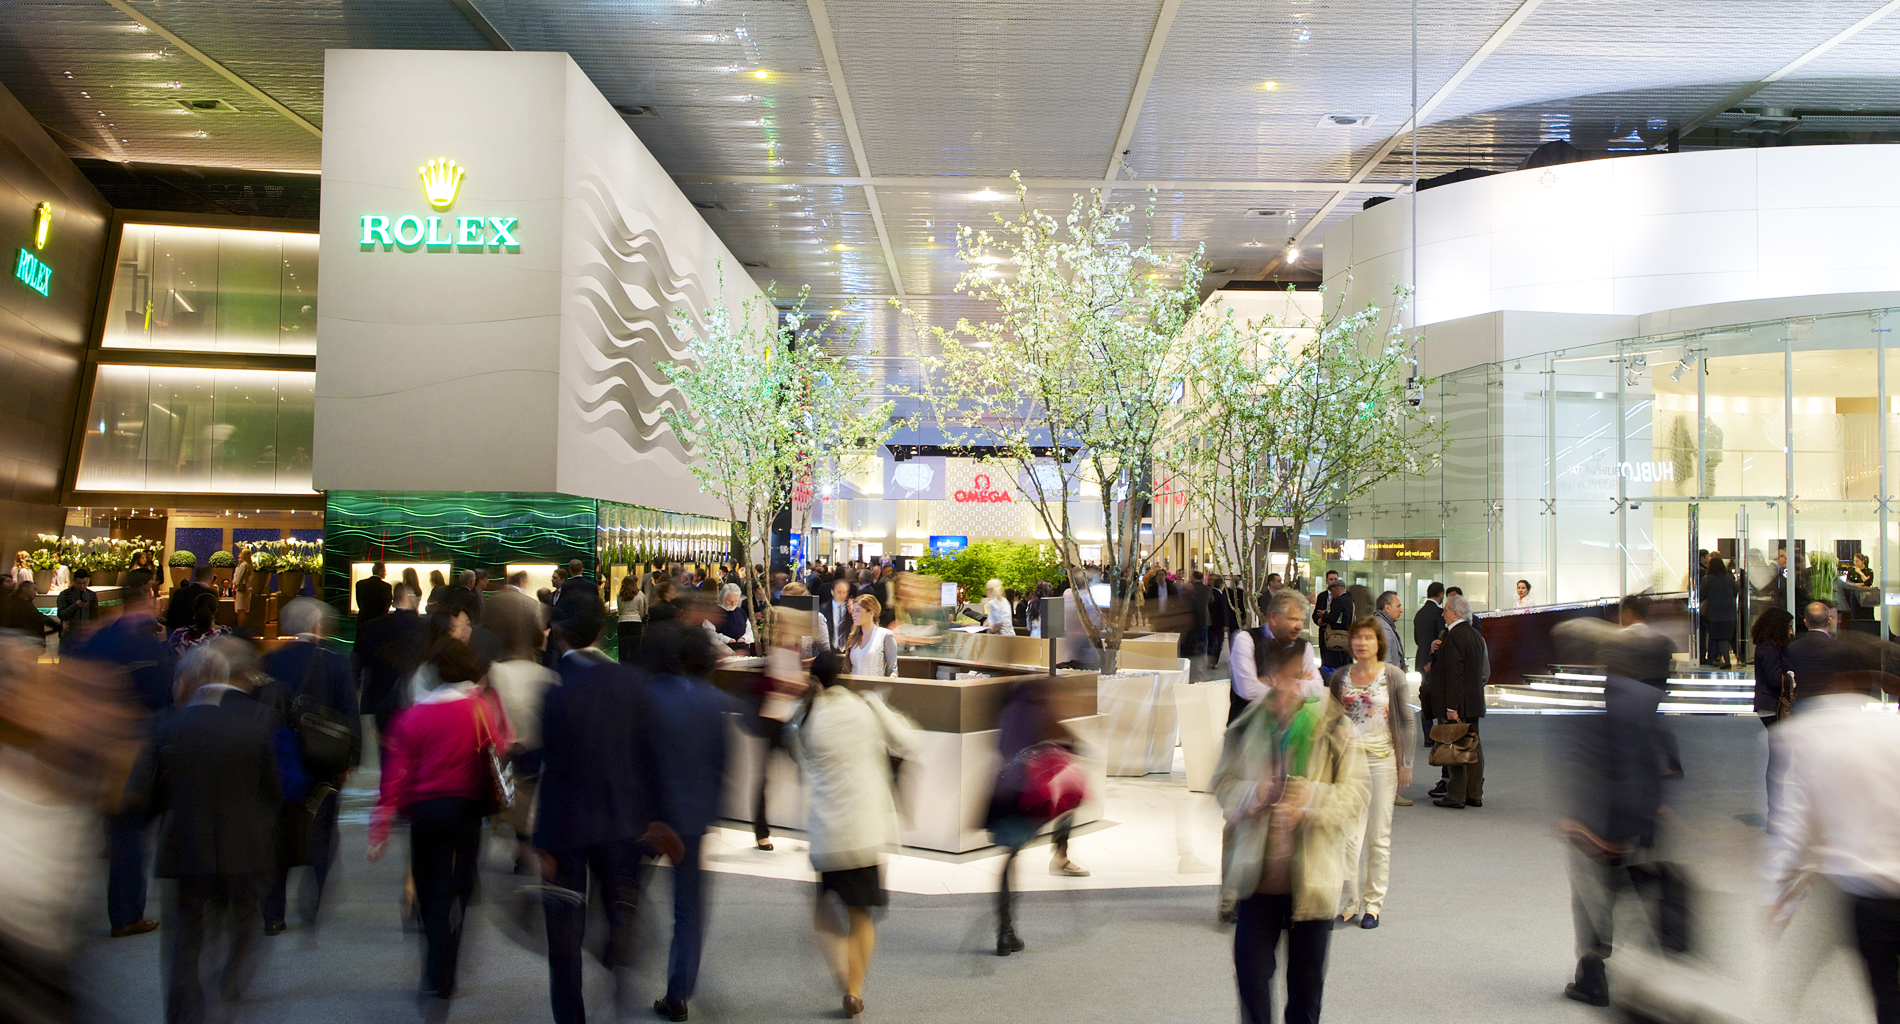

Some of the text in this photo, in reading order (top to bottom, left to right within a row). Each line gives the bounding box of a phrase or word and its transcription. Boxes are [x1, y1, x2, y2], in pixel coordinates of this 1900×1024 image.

[360, 214, 521, 247] ROLEX
[16, 247, 53, 297] ROLEX
[954, 490, 1012, 503] OMEGA
